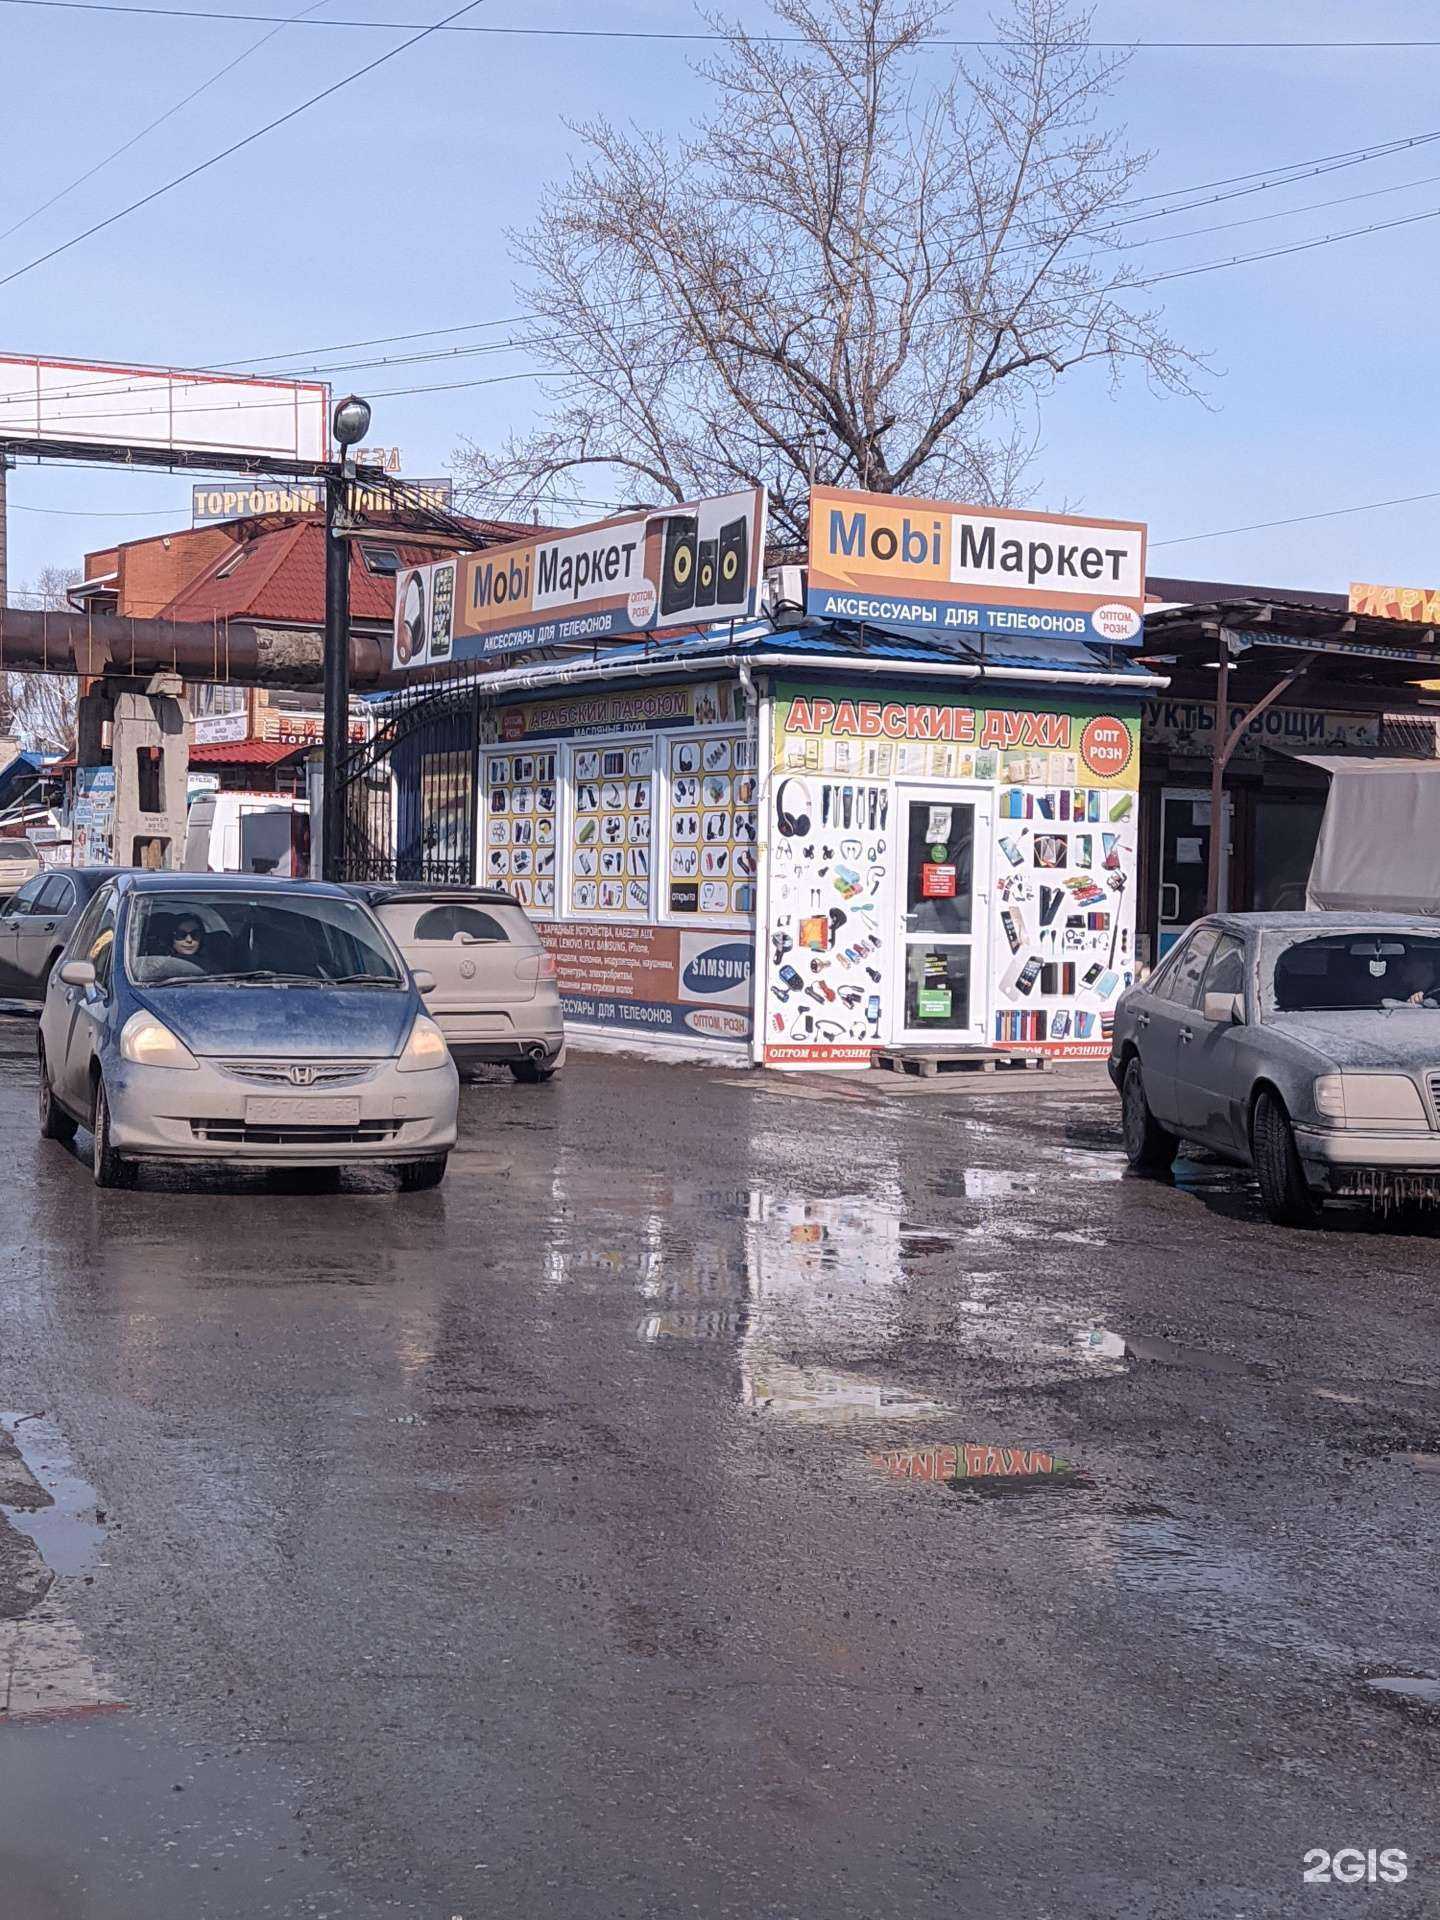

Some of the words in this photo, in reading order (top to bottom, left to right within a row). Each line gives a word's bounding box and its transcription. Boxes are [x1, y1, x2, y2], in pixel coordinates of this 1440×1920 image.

[194, 485, 316, 514] ТОРГОВЫЙ
[829, 510, 942, 565] Mobi
[960, 524, 1128, 584] Маркет
[473, 556, 530, 608] Mobi
[538, 542, 637, 599] Маркет
[824, 596, 937, 622] АКСЕССУАРЫ
[944, 608, 979, 626] ДЛЯ
[987, 611, 1086, 633] ТЕЛЕФОНОВ
[483, 628, 536, 651] АКСЕССУАРЫ
[537, 625, 555, 644] ДЛЯ
[558, 616, 612, 640] ТЕЛЕФОНОВ
[609, 691, 689, 721] ПАРФЮМ
[786, 697, 975, 742] АРАБСКИЕ
[981, 709, 1071, 750] ДУХИ
[1094, 729, 1119, 742] ОПТ
[1090, 746, 1122, 760] РОЗН
[692, 957, 751, 979] SAMSUNG
[560, 998, 595, 1016] ЕССУАРЫ
[598, 1003, 615, 1019] ДЛЯ
[618, 1006, 673, 1024] ТЕЛЕФОНОВ
[769, 1049, 810, 1058] ОПТОМ
